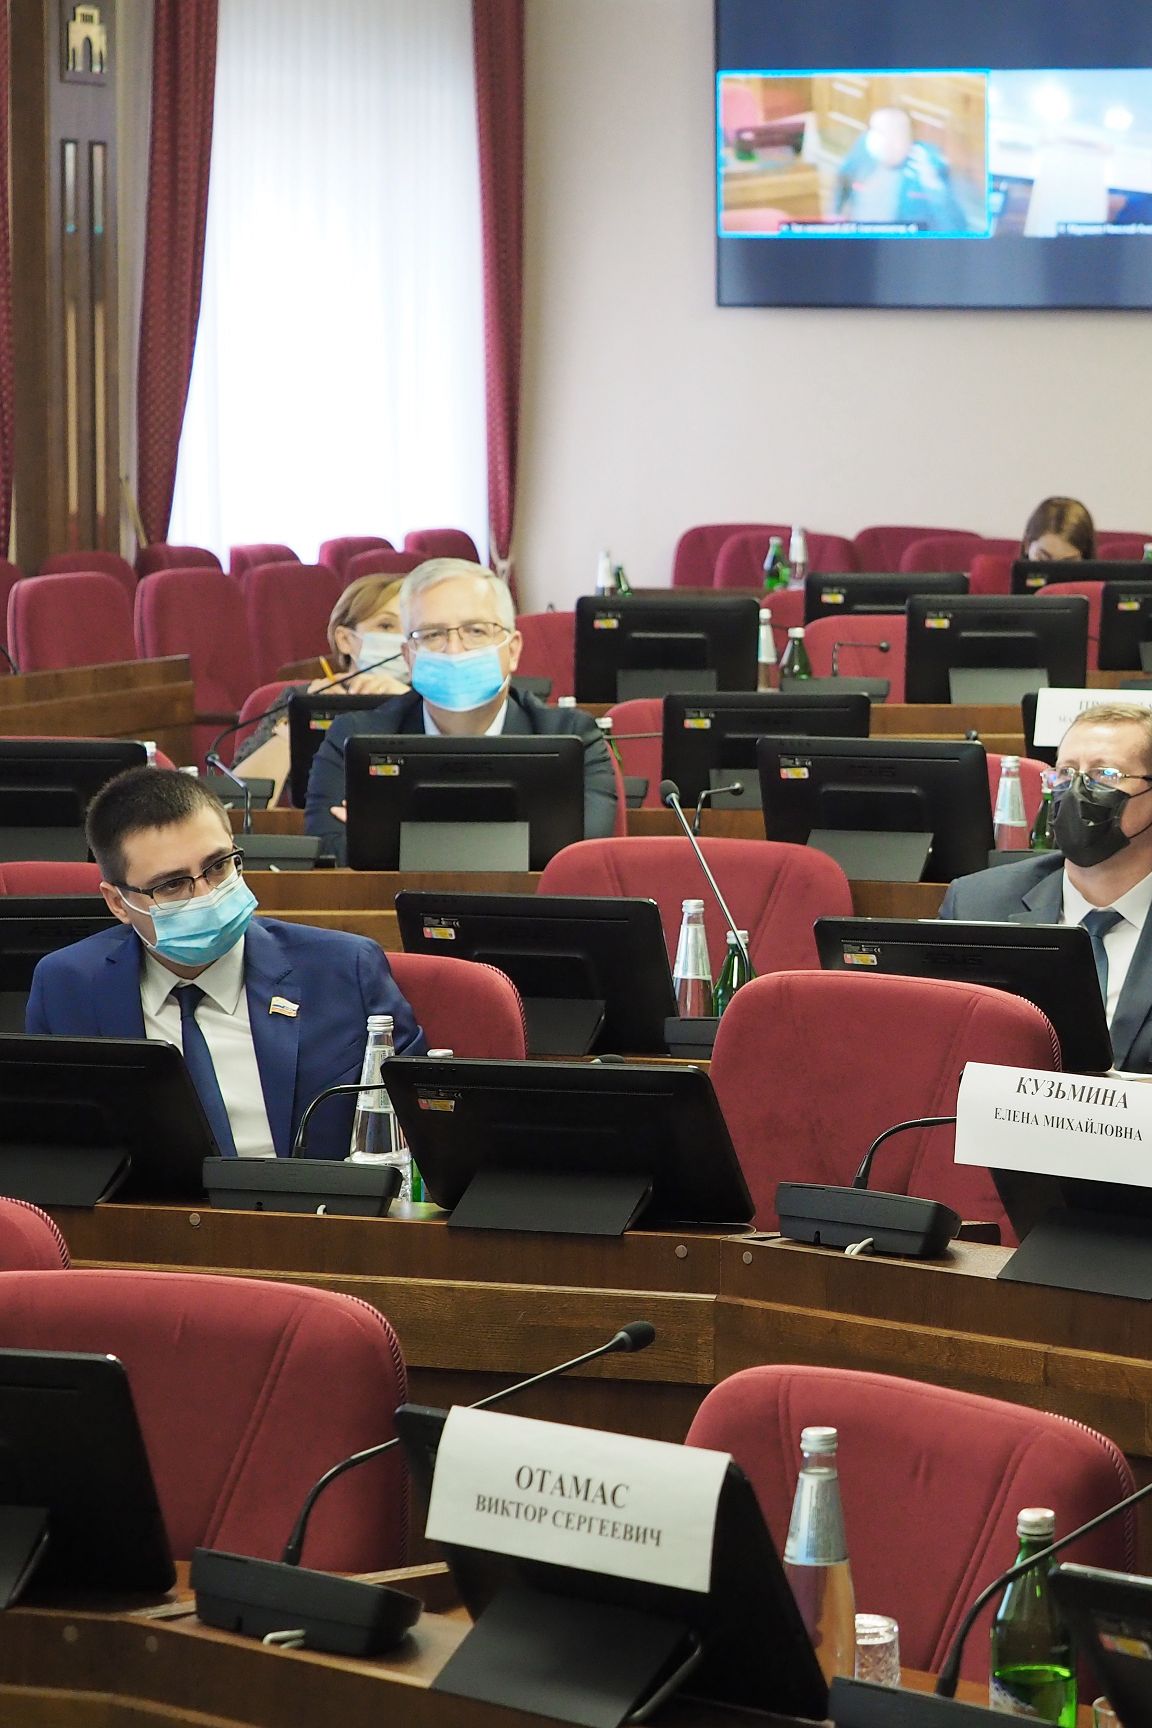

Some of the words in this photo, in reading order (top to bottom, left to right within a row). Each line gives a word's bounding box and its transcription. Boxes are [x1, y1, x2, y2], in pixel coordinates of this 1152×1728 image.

[1016, 1076, 1129, 1109] КУЗЬМИНА
[994, 1107, 1039, 1126] ЕЛЕНА
[1043, 1114, 1143, 1141] МИХАЙЛОВНА
[515, 1465, 630, 1509] ОТАМАС
[475, 1494, 548, 1524] ВИКТОР
[552, 1509, 663, 1547] СЕРГЕЕВИЧ
